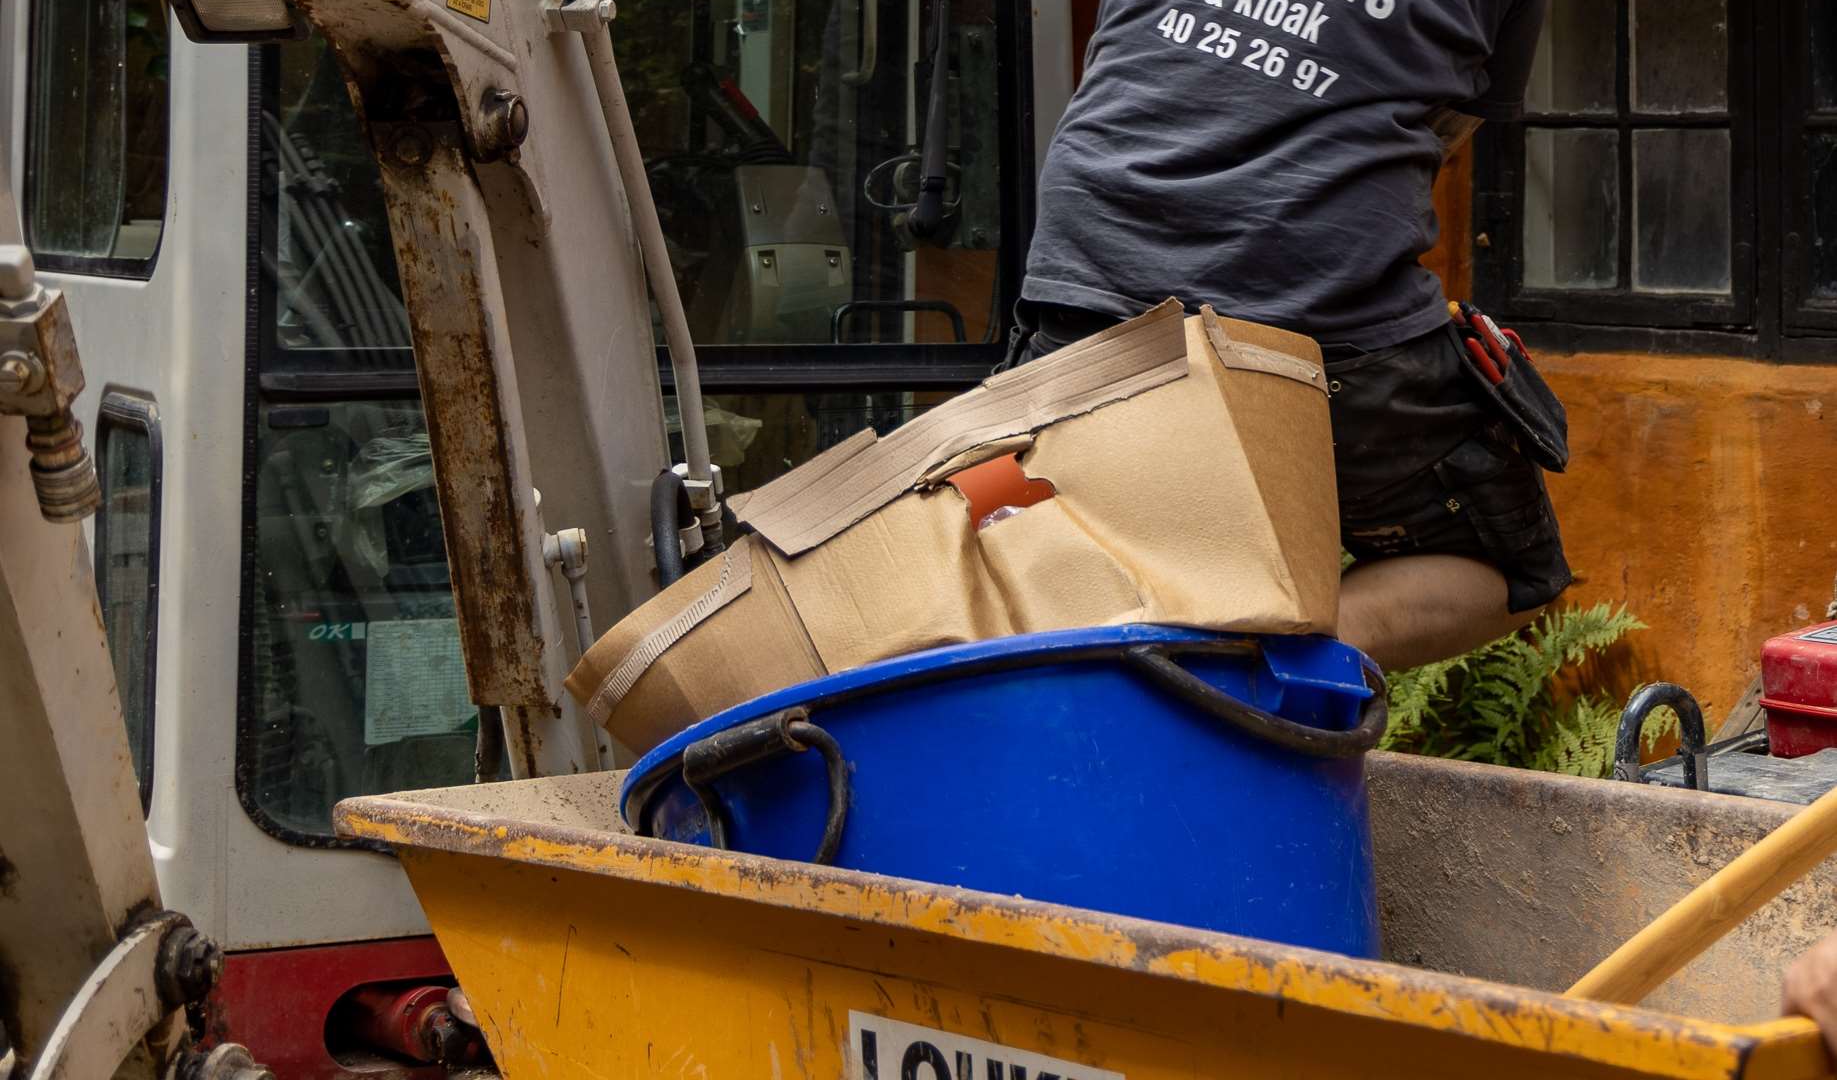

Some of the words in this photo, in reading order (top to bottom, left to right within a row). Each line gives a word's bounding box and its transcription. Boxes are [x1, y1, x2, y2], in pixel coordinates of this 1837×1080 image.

[1156, 8, 1196, 44] 40
[1195, 21, 1242, 59] 25
[1241, 38, 1290, 78] 26
[1291, 59, 1340, 99] 97
[309, 623, 350, 640] OK
